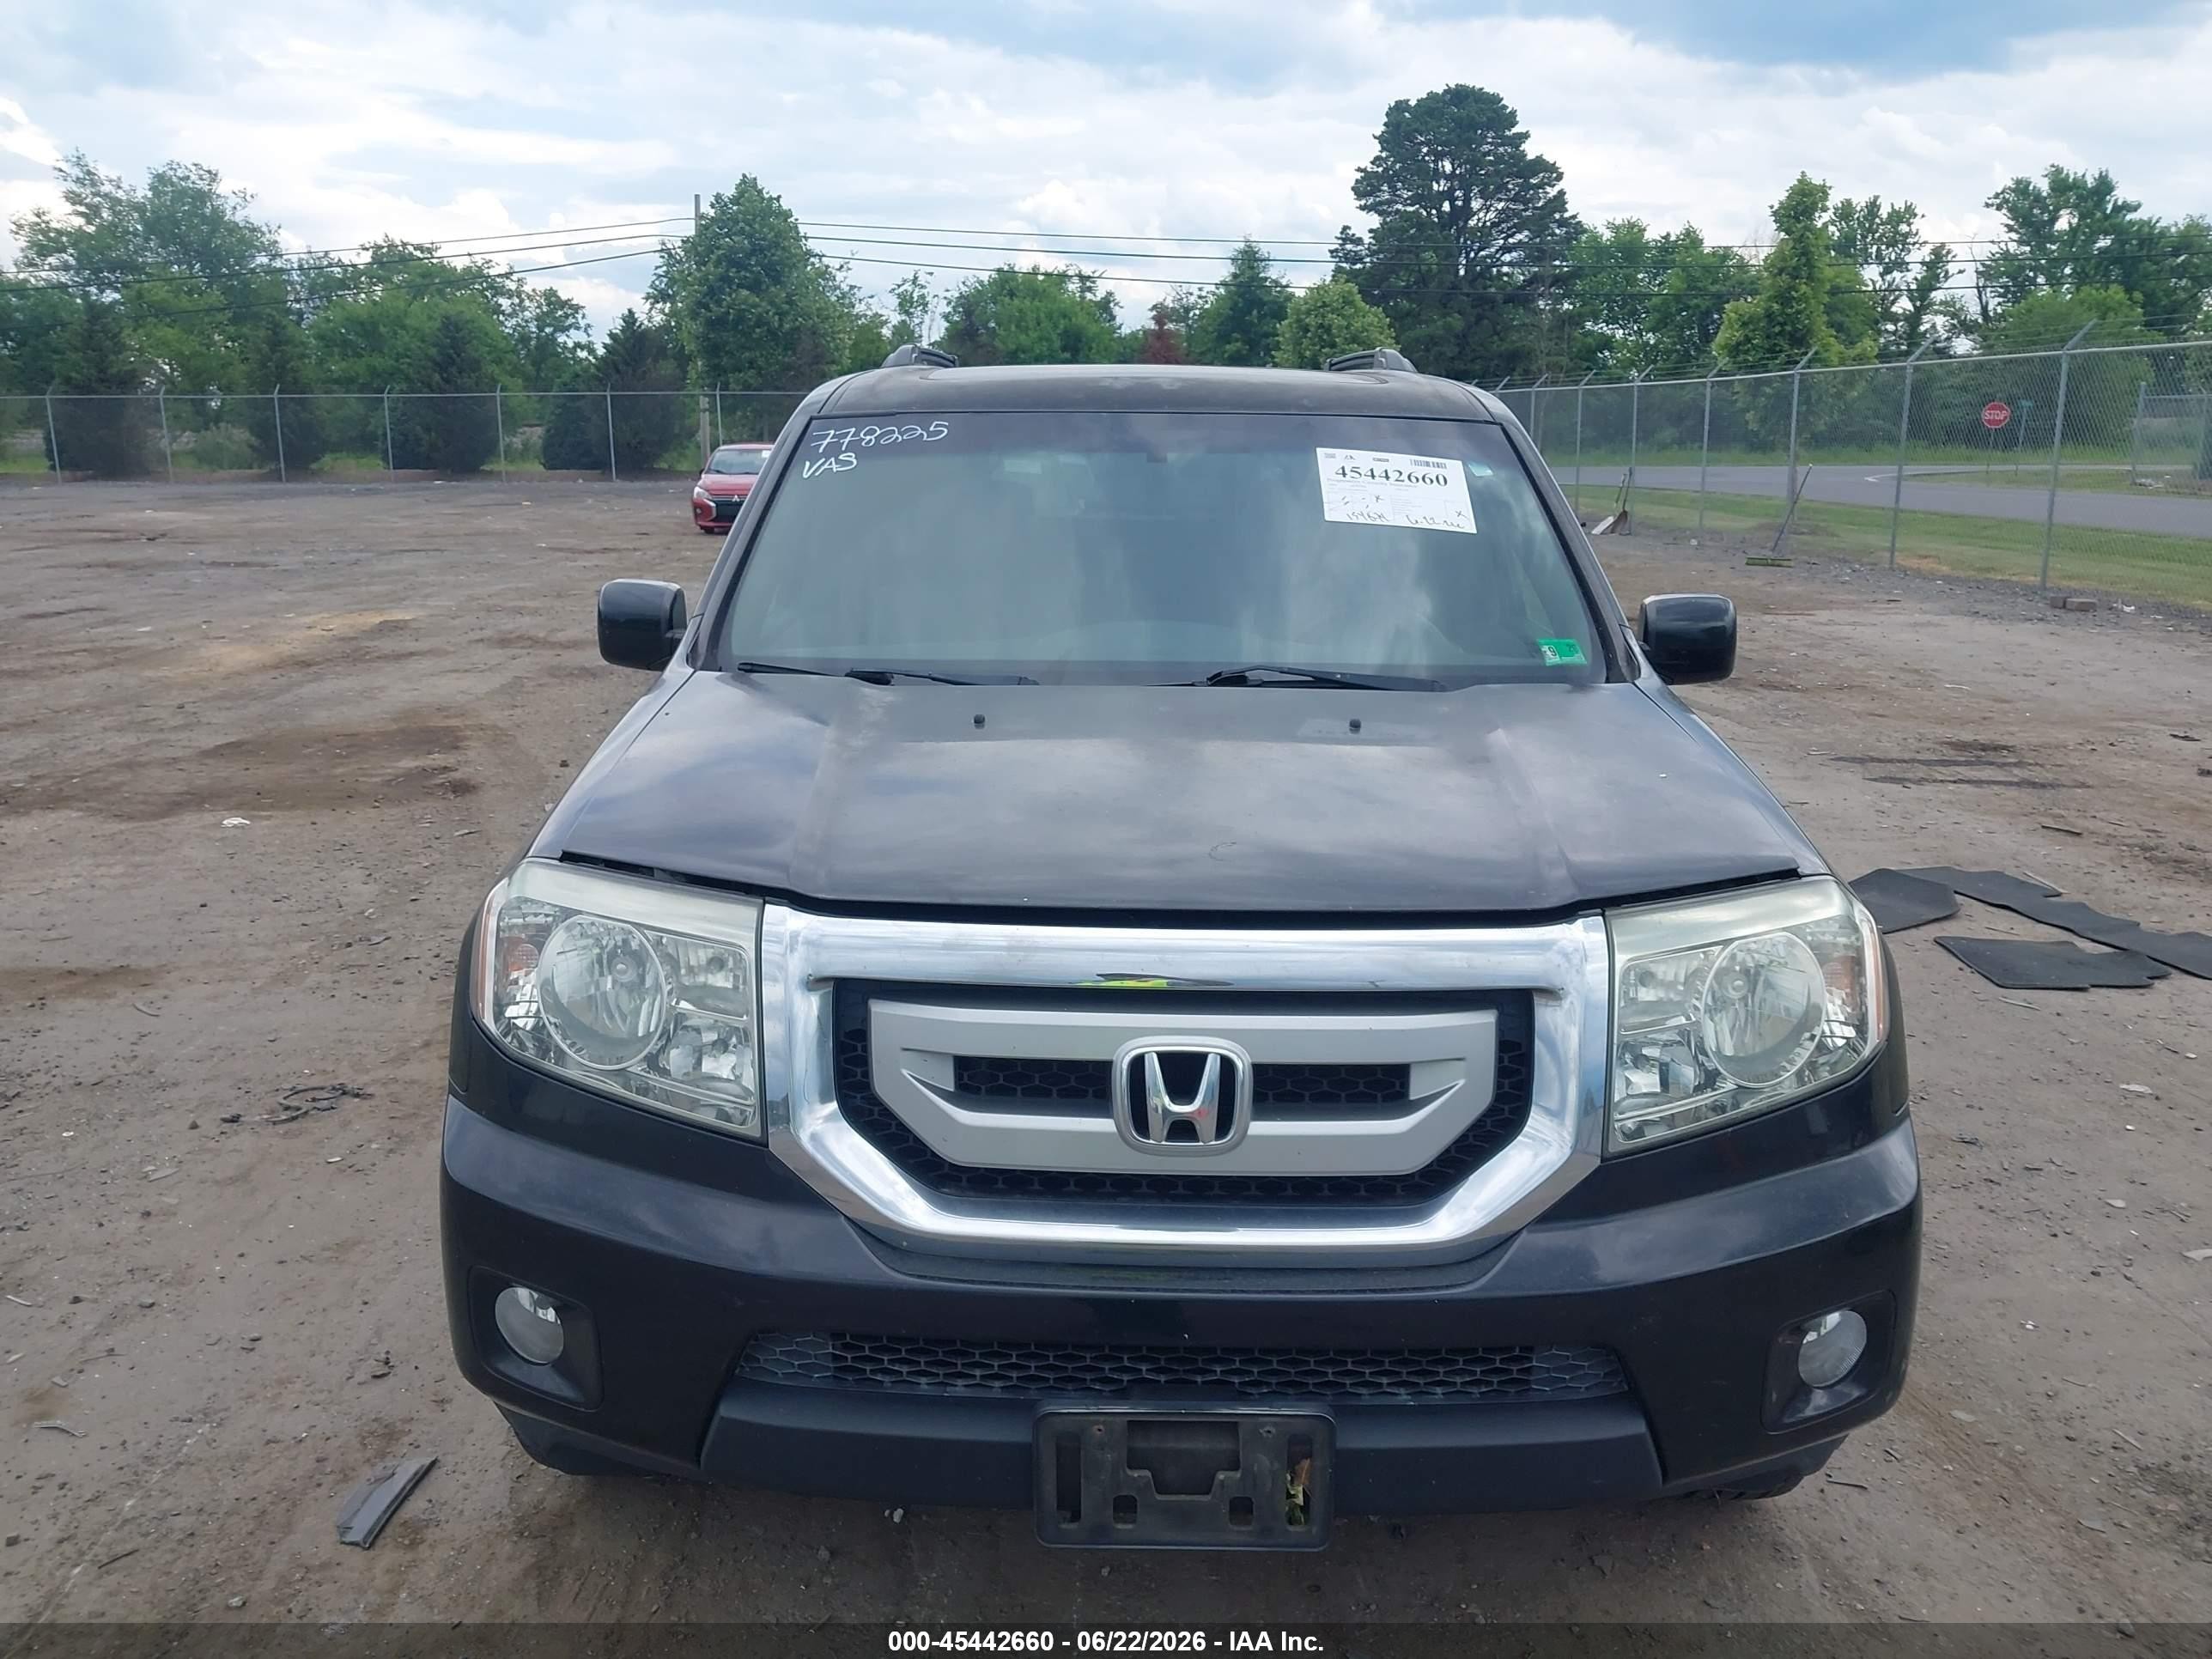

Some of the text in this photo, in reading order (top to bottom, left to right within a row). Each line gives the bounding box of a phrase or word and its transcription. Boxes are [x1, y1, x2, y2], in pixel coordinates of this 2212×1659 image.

[1984, 410, 2008, 420] STOP
[811, 421, 949, 453] 778225
[803, 452, 858, 479] VAS
[1334, 465, 1449, 487] 45442660
